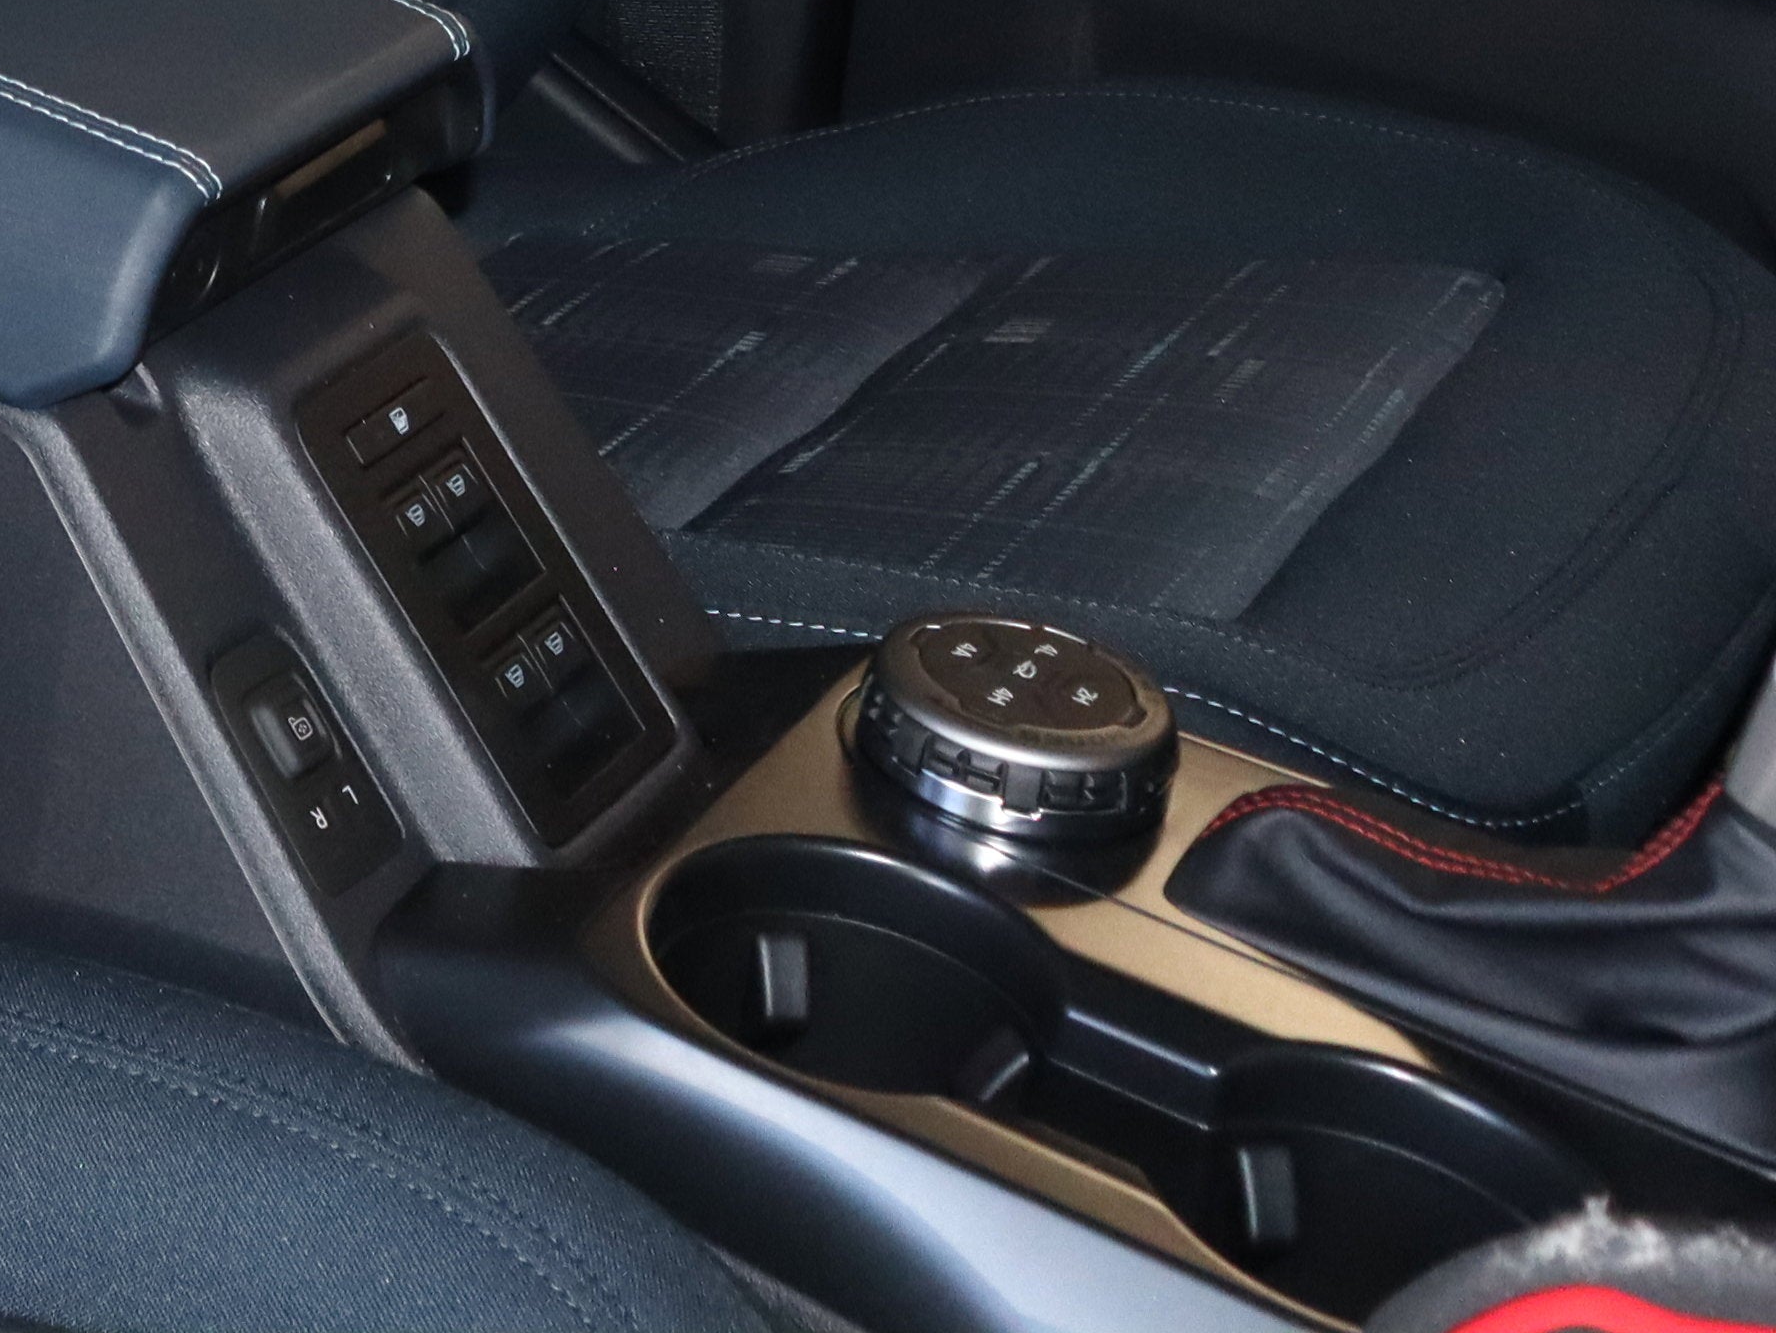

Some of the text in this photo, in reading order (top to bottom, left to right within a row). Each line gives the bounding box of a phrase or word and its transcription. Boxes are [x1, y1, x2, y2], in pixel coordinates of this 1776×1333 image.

[950, 641, 979, 659] 4A
[985, 685, 1015, 708] 4H
[341, 784, 360, 806] L
[309, 806, 329, 830] R
